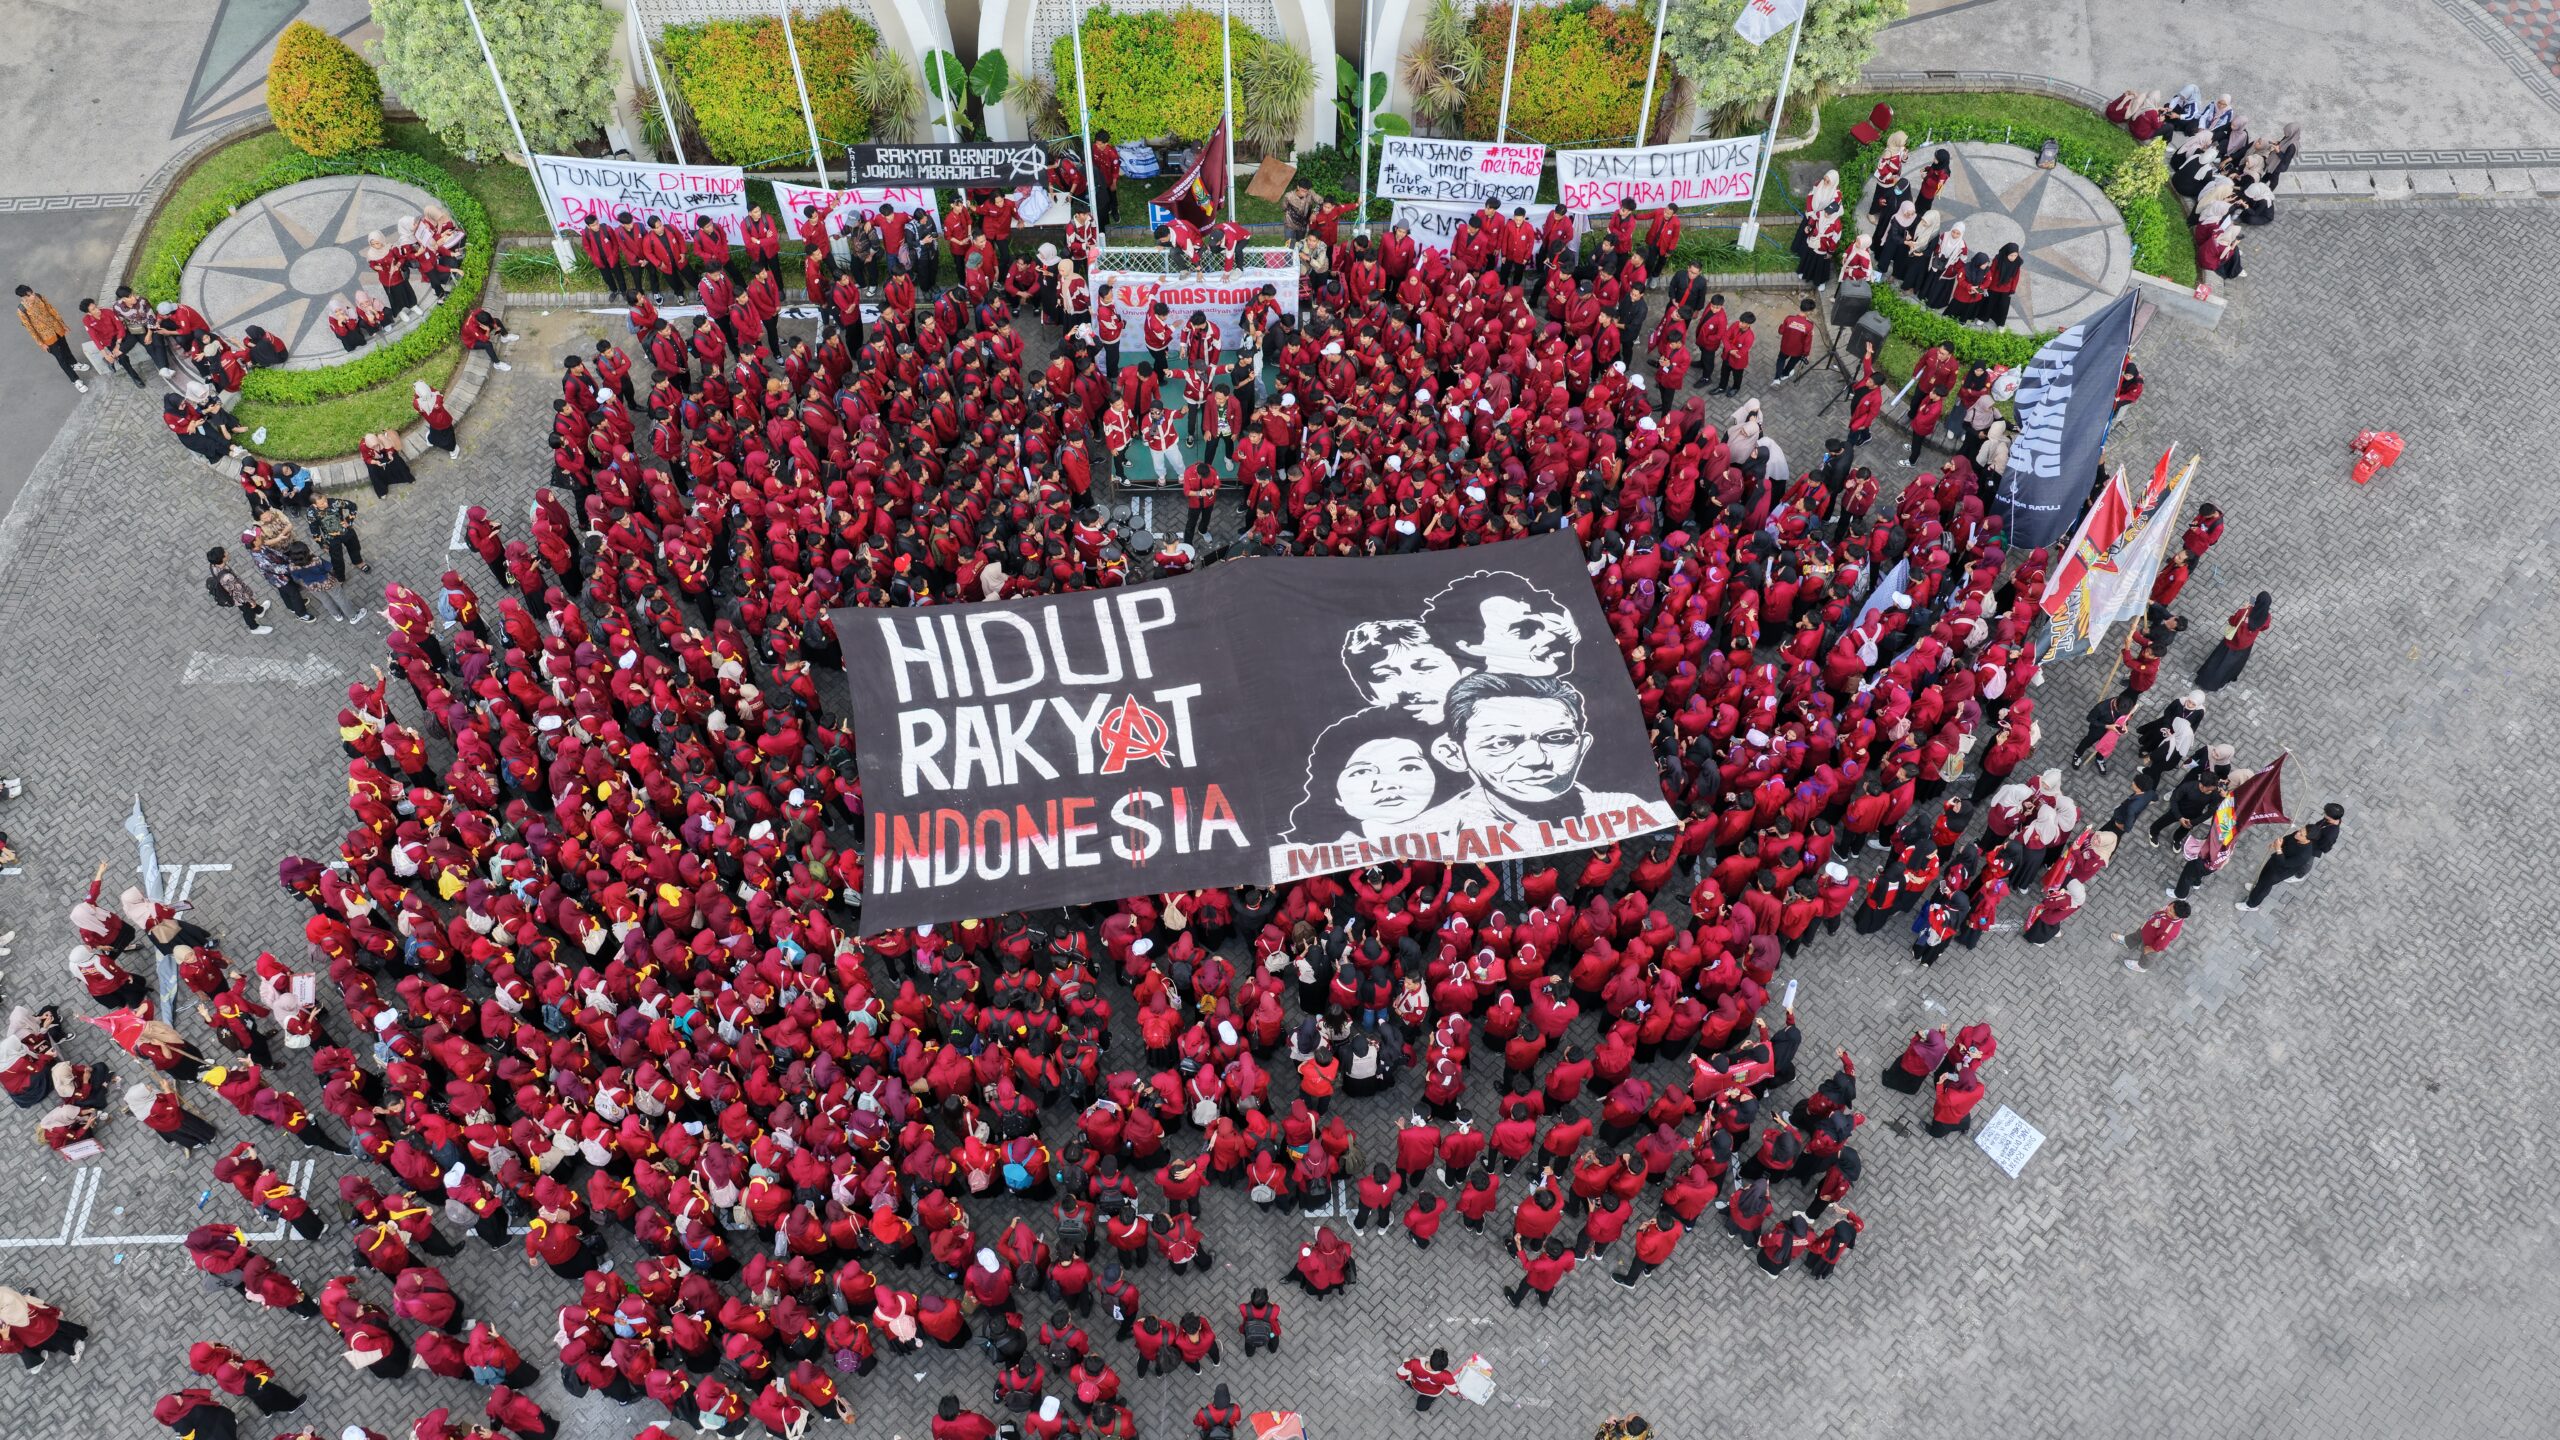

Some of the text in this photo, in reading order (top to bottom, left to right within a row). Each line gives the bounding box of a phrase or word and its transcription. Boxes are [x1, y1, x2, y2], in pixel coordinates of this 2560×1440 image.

[847, 147, 858, 184] KAIZEN
[876, 147, 943, 164] RAKYAT
[1389, 141, 1473, 162] PANJANG
[1574, 144, 1753, 179] DIAM DITINDAS
[543, 163, 652, 191] TUNDUK
[1428, 163, 1476, 182] umur
[619, 187, 681, 209] ATAU
[1564, 173, 1753, 209] BERSUARA DILINDAS
[1155, 205, 1171, 222] P
[877, 587, 1177, 703] HIDUP
[897, 683, 1201, 797] RAKYAT
[1287, 804, 1663, 880] MENOLAK LUPA
